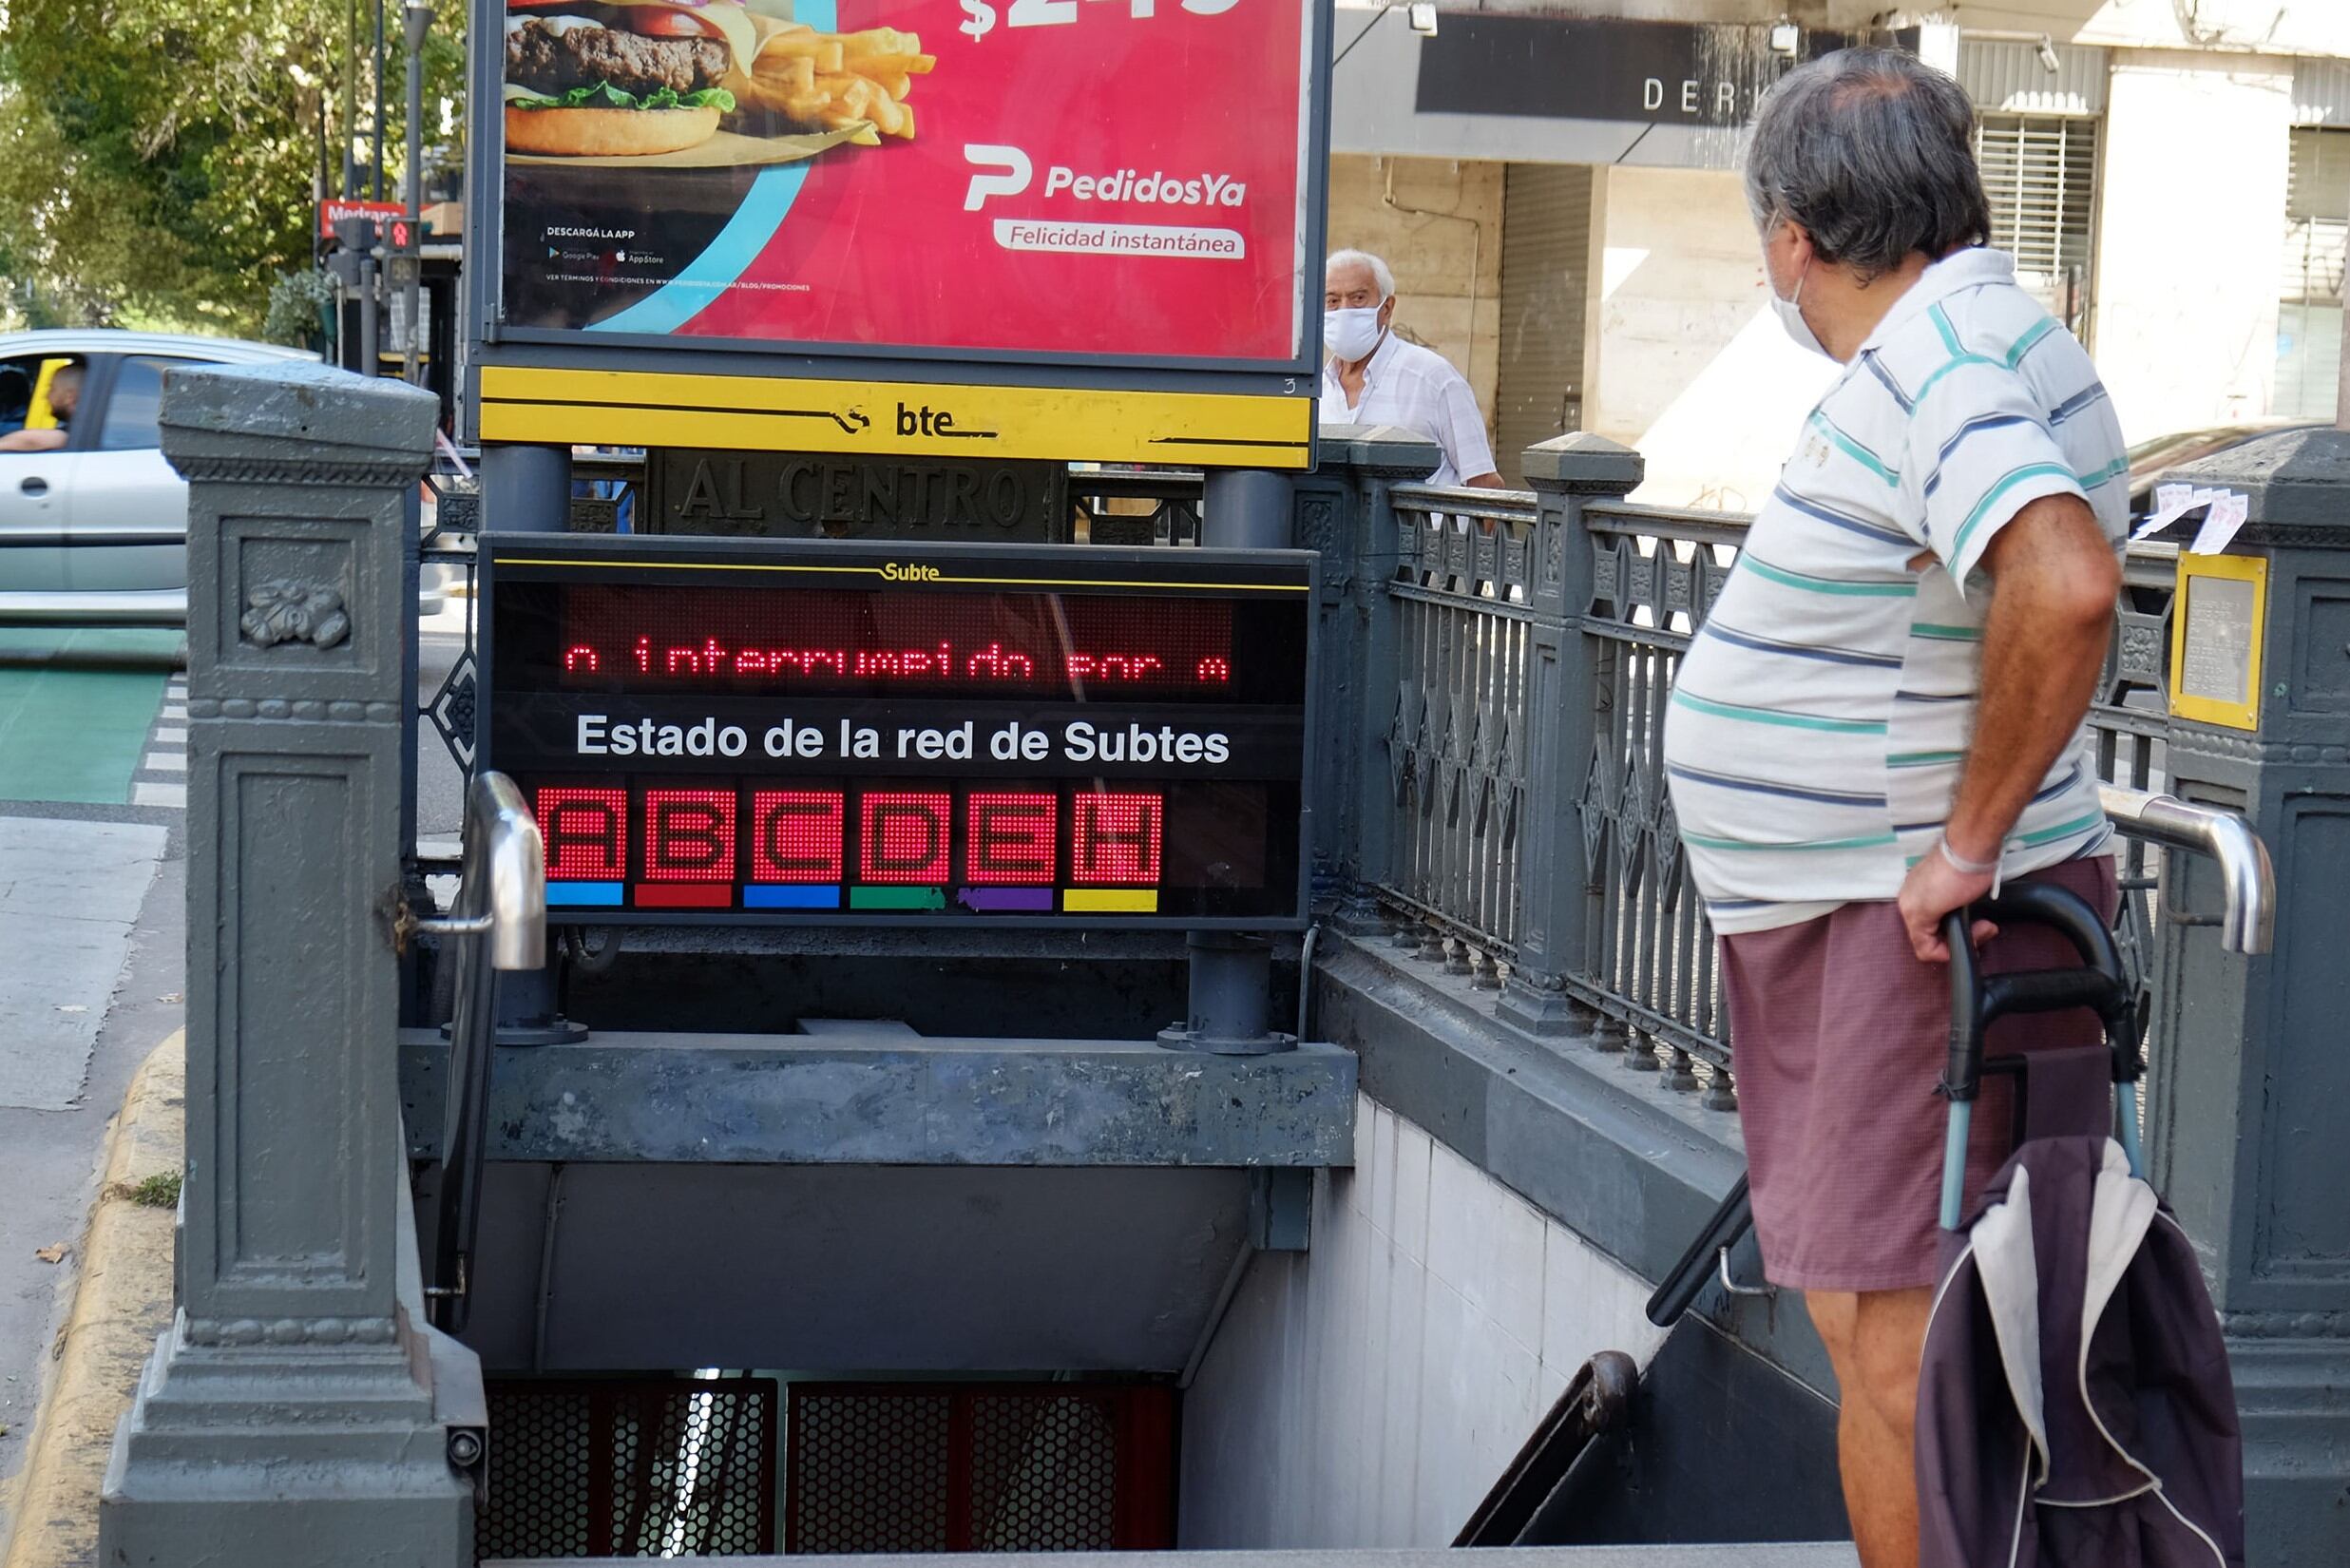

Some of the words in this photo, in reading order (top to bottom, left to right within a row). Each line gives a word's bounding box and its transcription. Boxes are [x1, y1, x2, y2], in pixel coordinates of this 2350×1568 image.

[1044, 166, 1246, 206] PedidosYa
[615, 230, 636, 239] APP
[1010, 225, 1105, 247] Felicidad
[1111, 230, 1235, 253] instantánea
[679, 457, 765, 521] AL
[778, 459, 1027, 528] CENTRO
[884, 563, 940, 583] Subte
[577, 715, 748, 757] Estado
[764, 718, 824, 757] de
[841, 718, 880, 757] la
[897, 721, 974, 759] red
[990, 722, 1049, 761] de
[1064, 722, 1231, 763] Subtes
[548, 801, 617, 868] A
[659, 802, 725, 868] B
[765, 804, 832, 870] C
[872, 805, 939, 870] D
[978, 806, 1045, 870] E
[1084, 807, 1152, 871] H
